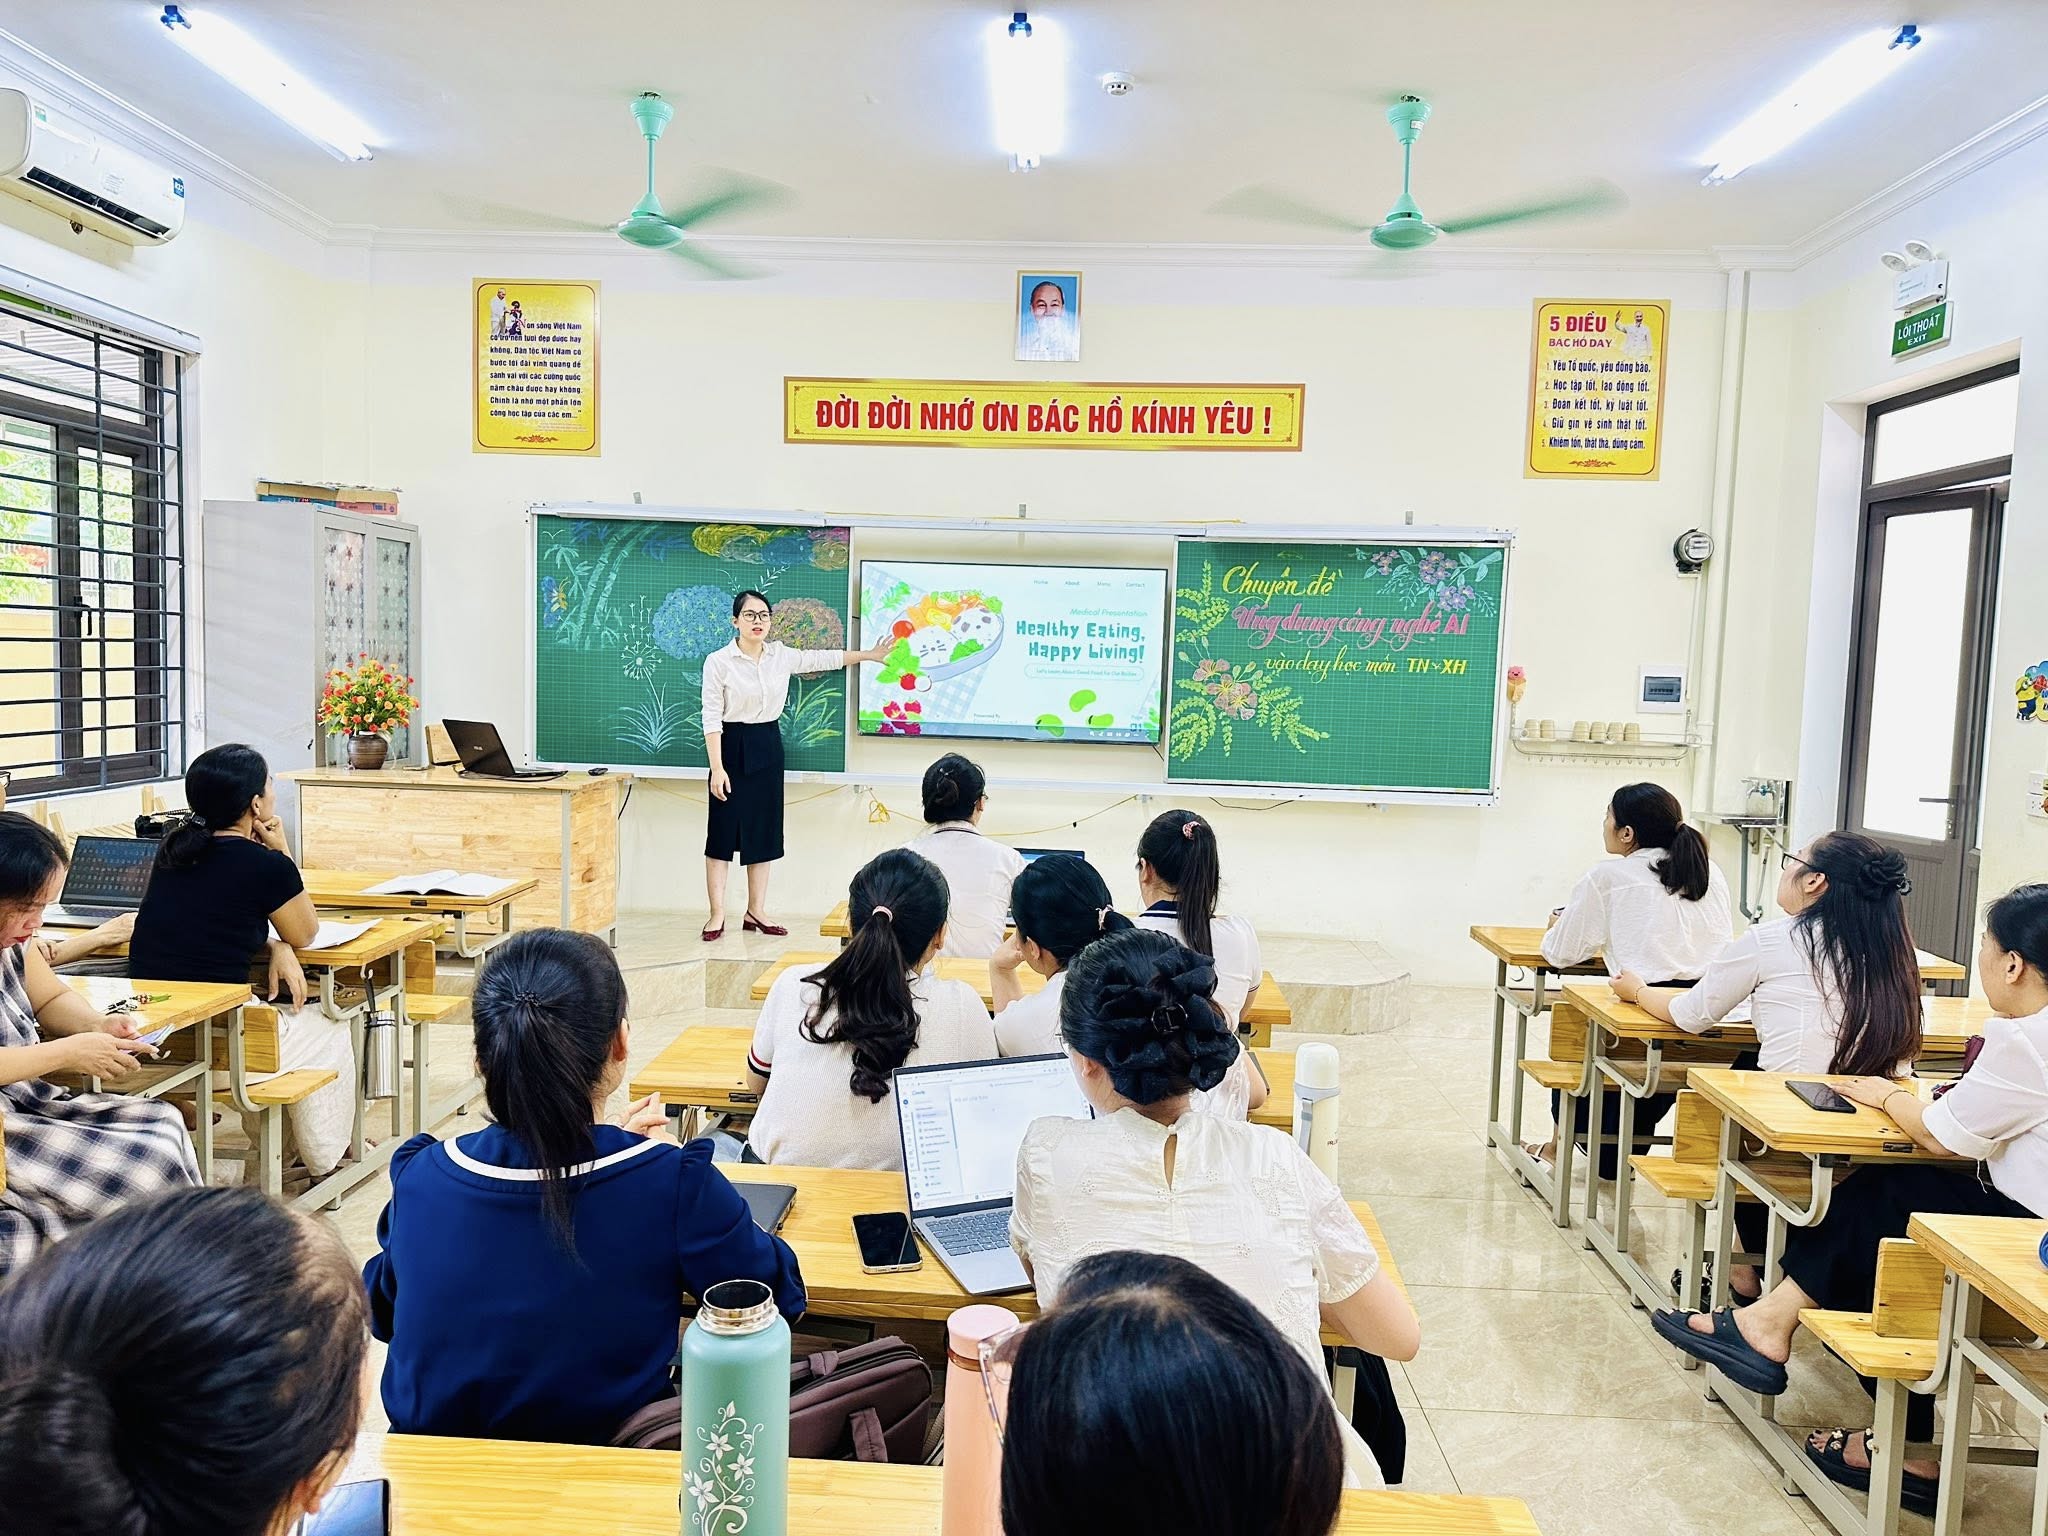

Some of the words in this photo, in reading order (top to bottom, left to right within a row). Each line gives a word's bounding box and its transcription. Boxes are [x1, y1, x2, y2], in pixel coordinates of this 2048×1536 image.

[1550, 316, 1560, 332] 5
[1566, 310, 1606, 332] ĐIỀU
[1912, 312, 1940, 334] THOÁT
[1908, 332, 1927, 346] EXIT
[1601, 380, 1612, 391] lao
[816, 394, 859, 428] ĐỜI
[868, 395, 911, 429] ĐỜI
[920, 397, 974, 431] NHỚ
[983, 401, 1018, 432] ƠN
[1027, 398, 1079, 432] BÁC
[1088, 396, 1123, 433] HỒ
[1132, 400, 1195, 434] KÍNH
[1204, 400, 1254, 434] YÊU
[1264, 407, 1271, 434] !
[1597, 419, 1612, 429] sinh
[1222, 562, 1306, 604] Chuyên
[1069, 608, 1100, 616] Medical
[1102, 609, 1148, 617] Presentation
[1016, 620, 1080, 639] Healthy
[1087, 623, 1145, 642] Eating,
[1443, 613, 1470, 635] AI
[1029, 642, 1082, 662] Happy
[1089, 643, 1145, 664] Living!
